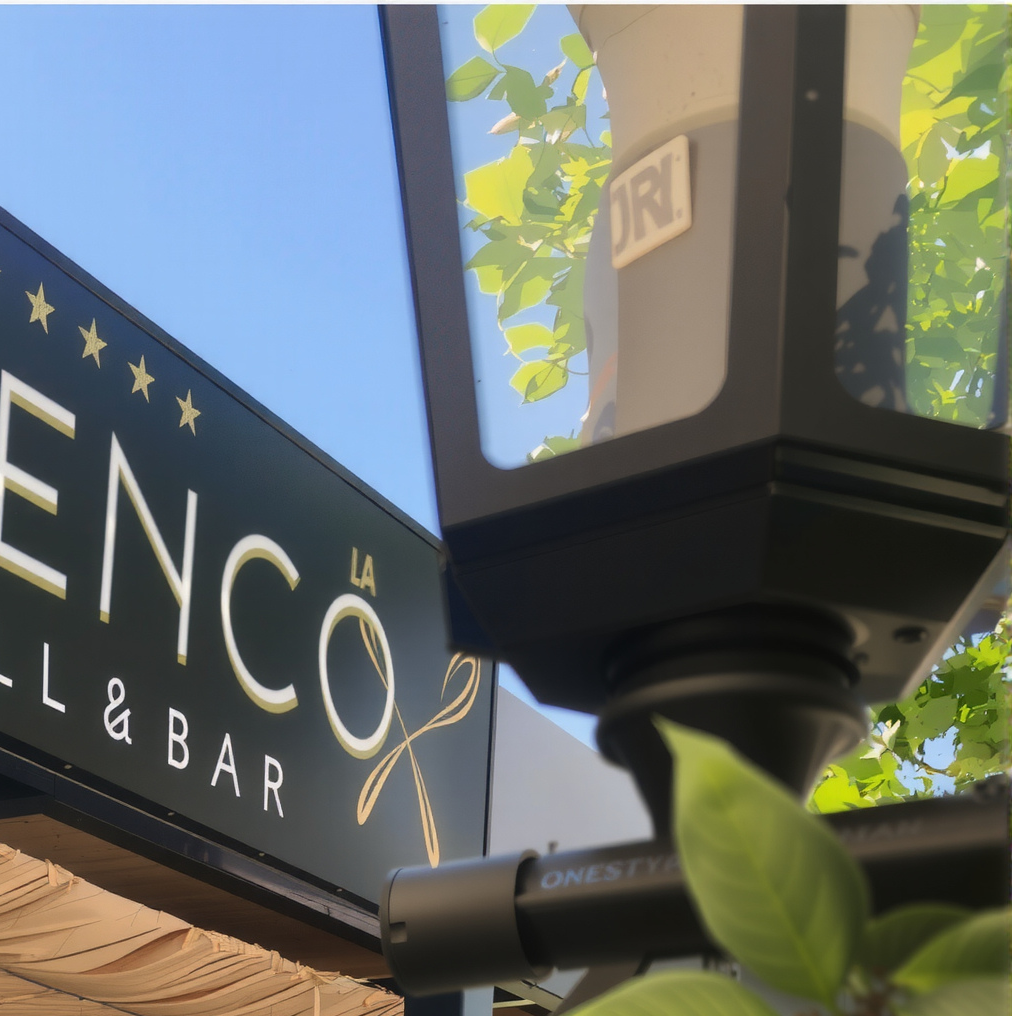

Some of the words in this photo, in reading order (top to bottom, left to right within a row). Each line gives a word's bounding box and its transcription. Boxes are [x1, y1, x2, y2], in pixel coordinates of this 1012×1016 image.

[350, 546, 376, 598] LA
[103, 677, 133, 745] &
[168, 707, 285, 818] BAR
